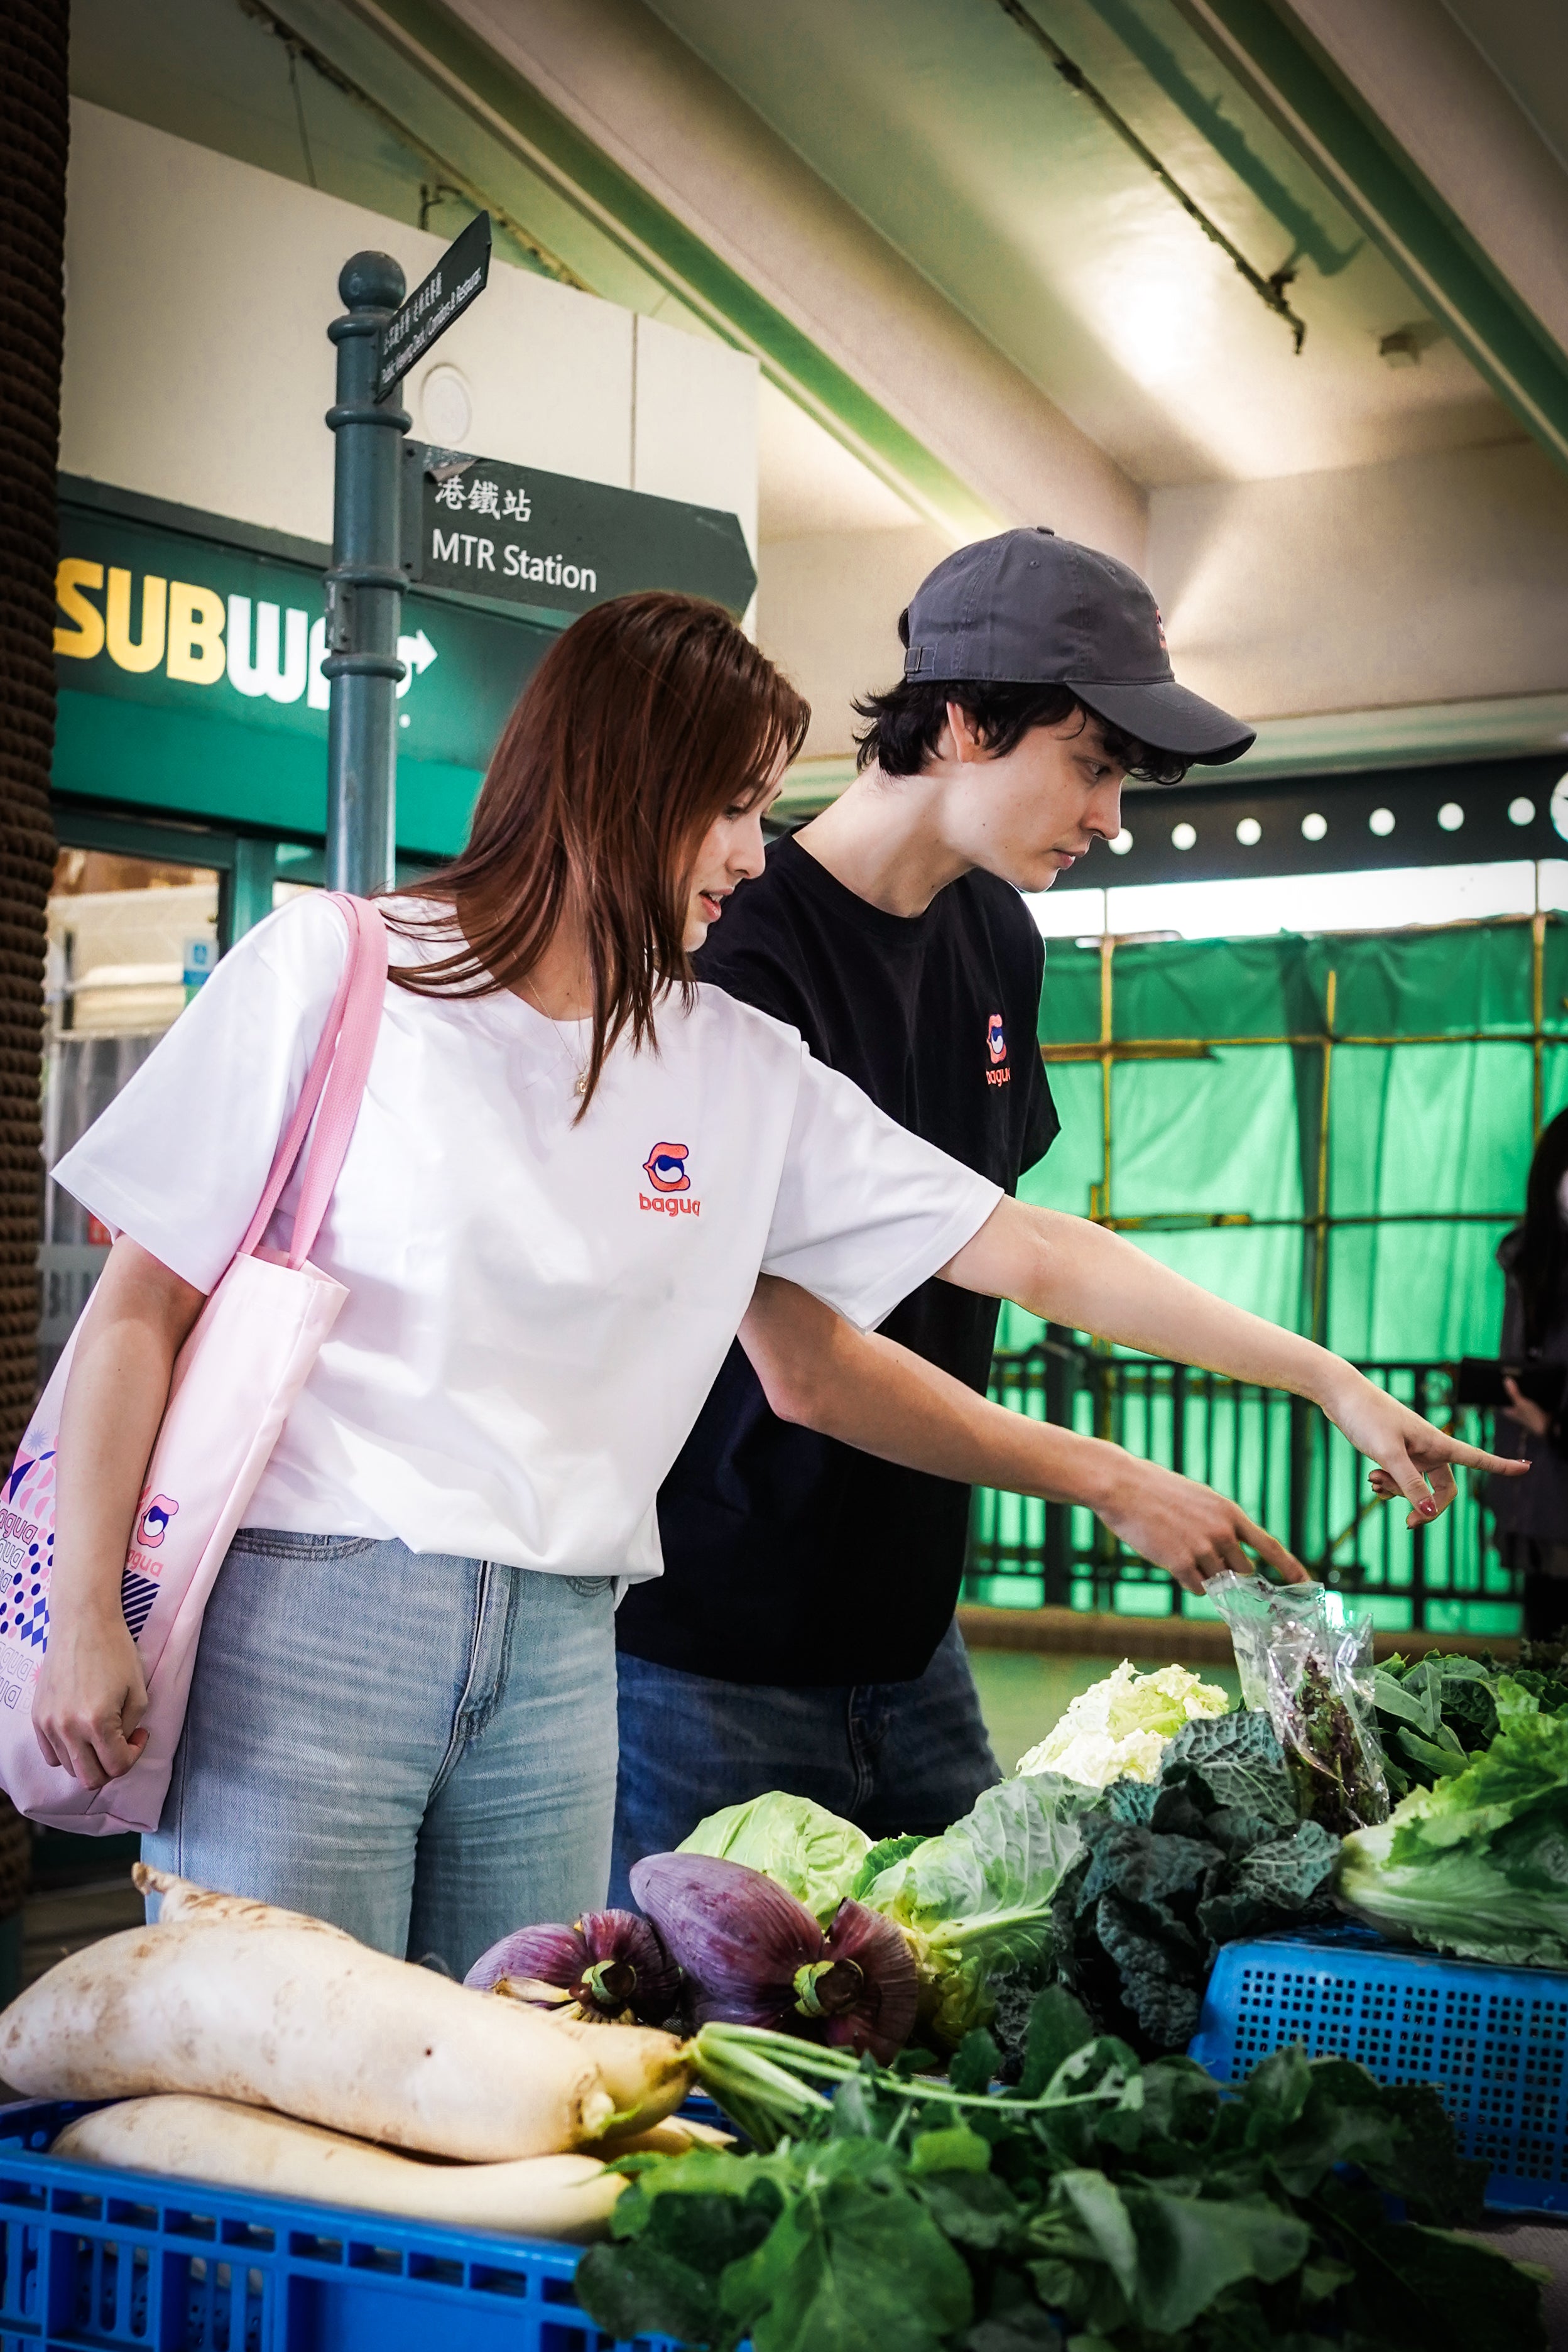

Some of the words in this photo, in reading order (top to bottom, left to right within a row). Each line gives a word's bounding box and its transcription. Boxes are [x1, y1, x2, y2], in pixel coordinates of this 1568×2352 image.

[435, 476, 531, 523] 港鐵站
[432, 528, 496, 572] MTR
[503, 544, 597, 593] Station
[0, 1508, 38, 1545] agua
[127, 1549, 164, 1577] agua
